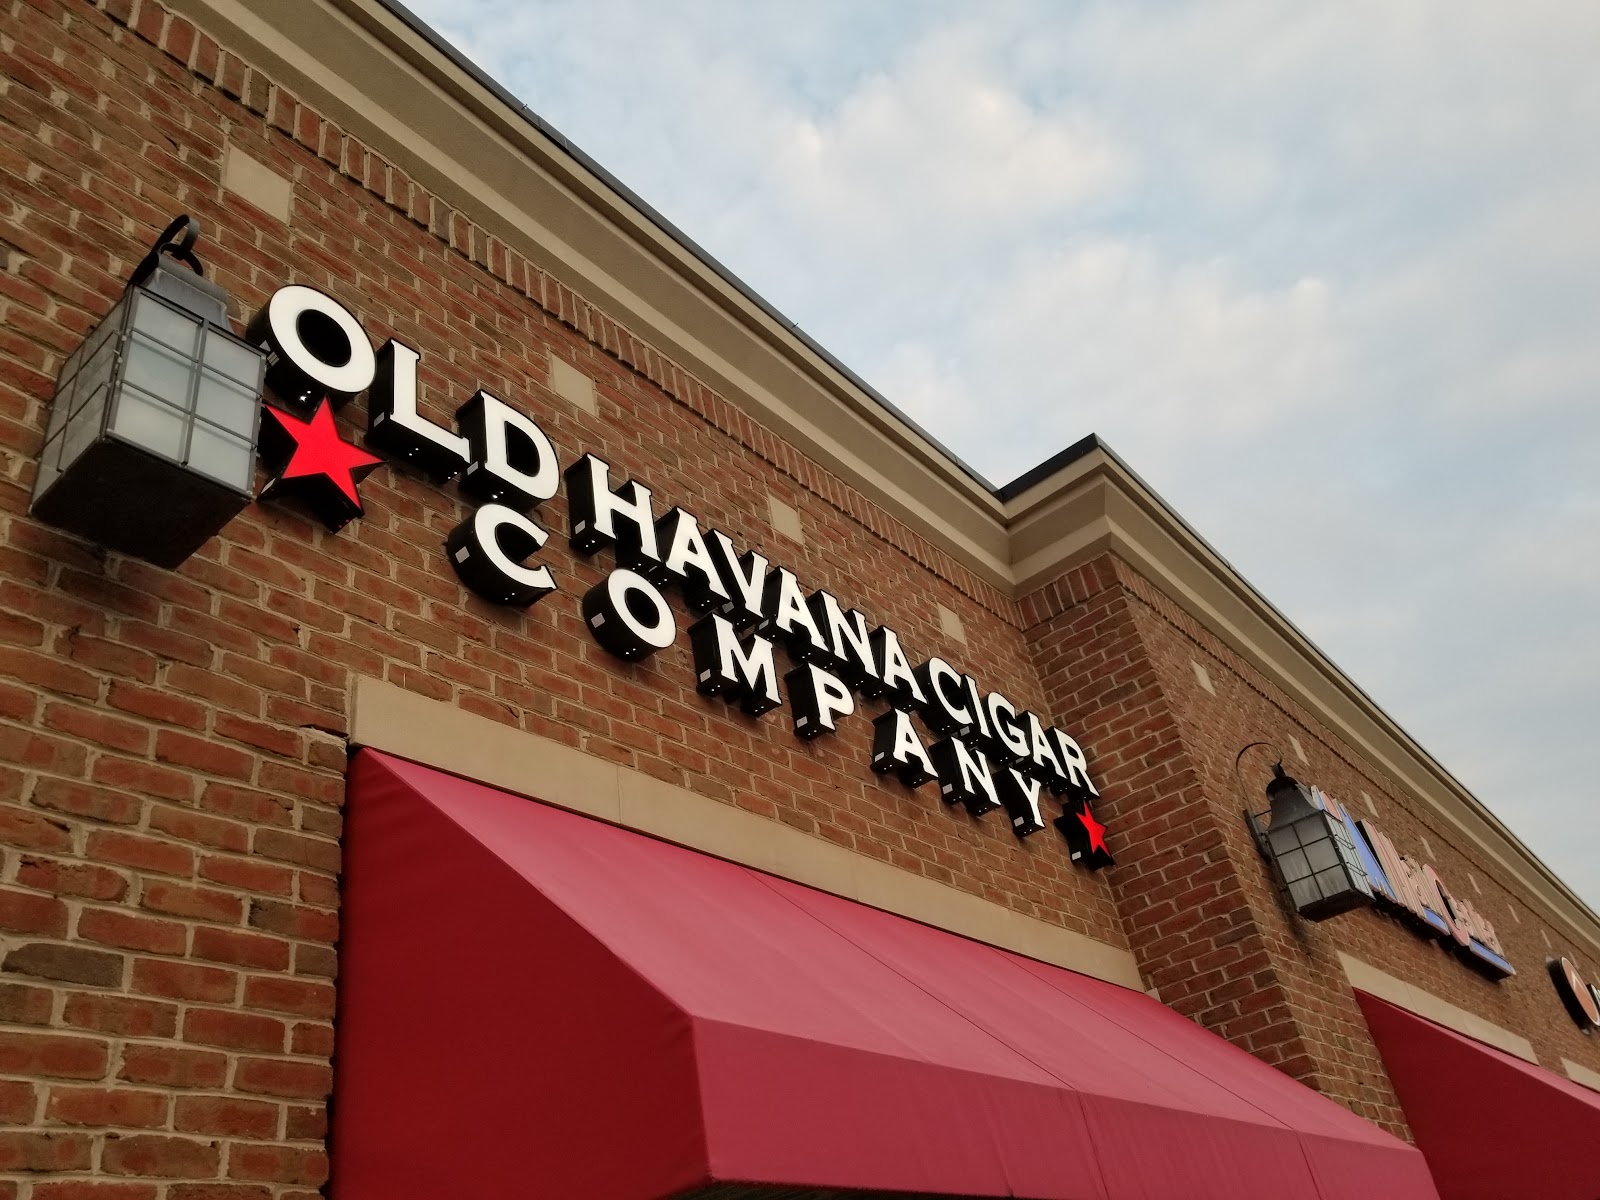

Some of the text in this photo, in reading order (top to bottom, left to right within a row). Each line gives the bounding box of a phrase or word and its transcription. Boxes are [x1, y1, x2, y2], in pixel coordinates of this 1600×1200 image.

[268, 284, 1099, 797] OLD HAVANA CIGAR
[474, 503, 1045, 827] COMPANY
